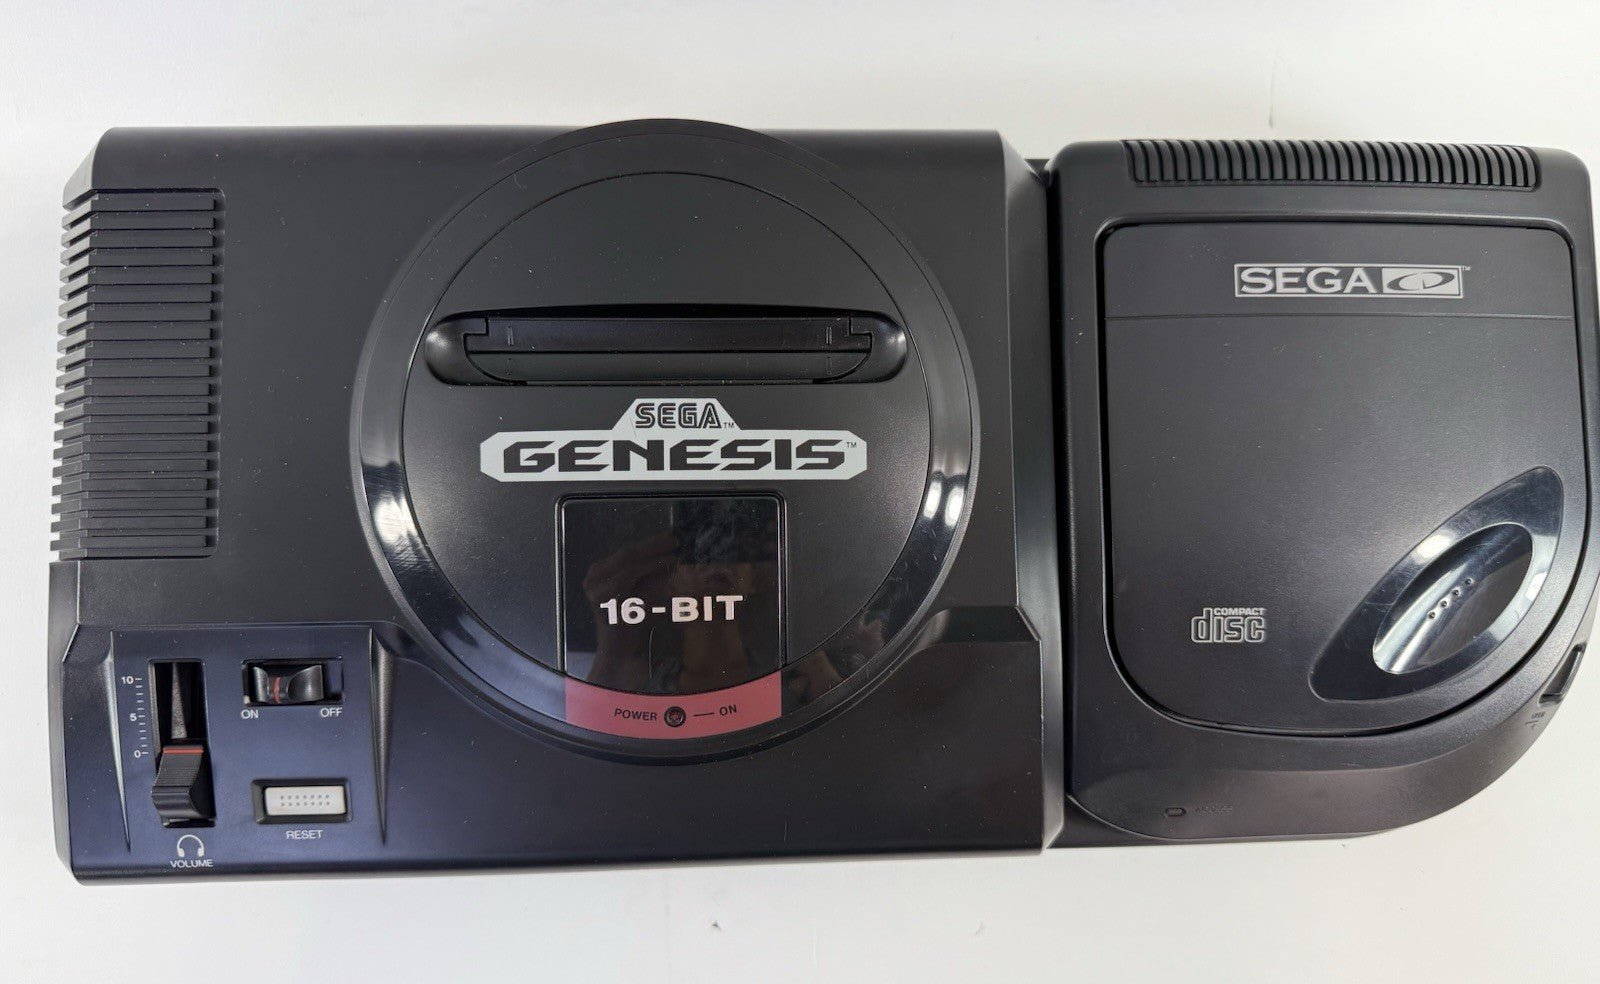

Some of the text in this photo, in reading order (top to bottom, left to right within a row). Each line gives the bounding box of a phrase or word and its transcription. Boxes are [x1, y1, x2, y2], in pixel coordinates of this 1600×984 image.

[1240, 267, 1377, 293] SEGA
[635, 403, 722, 429] SEGA
[503, 438, 846, 474] GENESIS
[600, 595, 744, 625] 16-BIT
[1213, 607, 1266, 616] COMPACT
[1191, 607, 1265, 643] disc
[121, 675, 134, 685] 10
[129, 712, 137, 722] 5
[241, 707, 343, 720] ON OFF
[614, 704, 738, 722] POWER ON
[134, 749, 142, 759] 0
[286, 829, 324, 840] RESET
[170, 858, 214, 869] VOLUME
